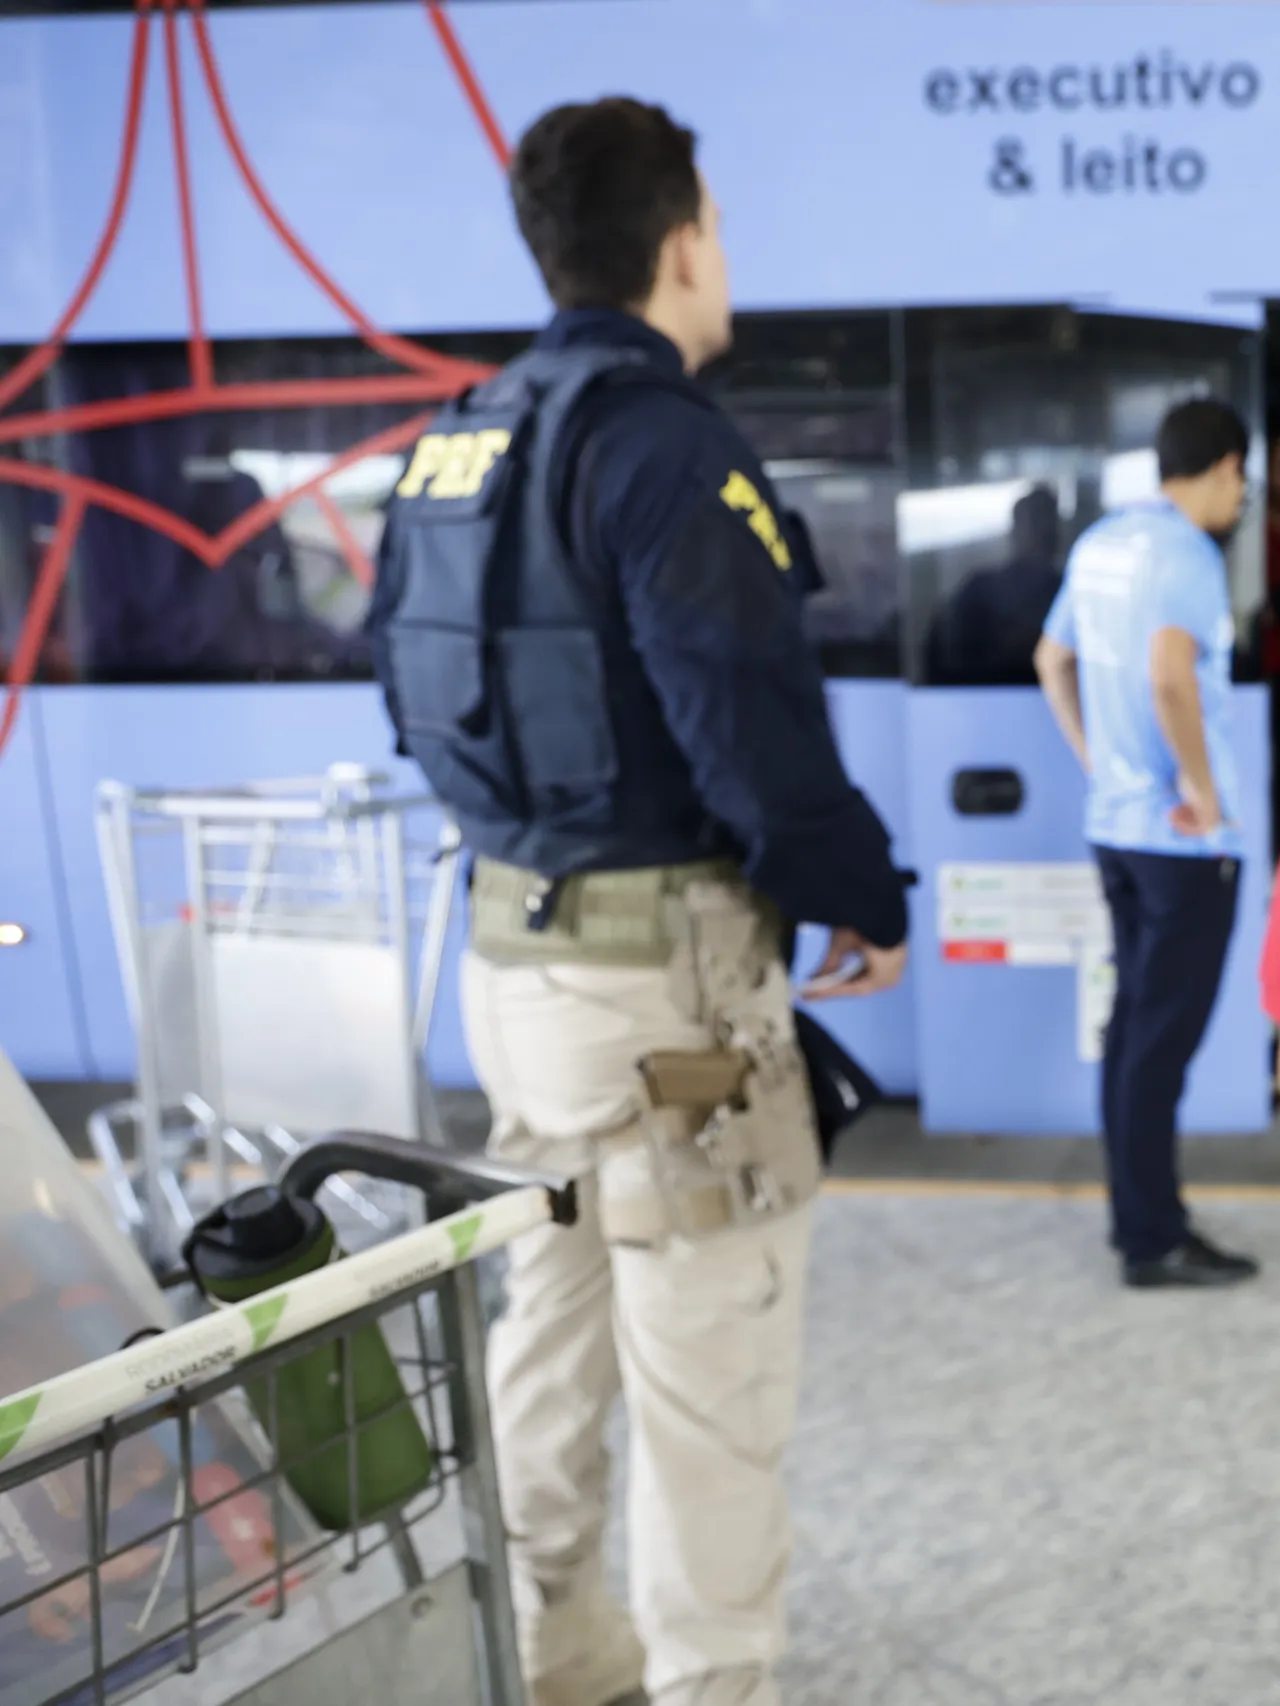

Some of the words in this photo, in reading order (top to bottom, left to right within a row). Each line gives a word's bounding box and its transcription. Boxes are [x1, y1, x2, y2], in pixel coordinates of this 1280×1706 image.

[924, 46, 1260, 114] executivo
[987, 136, 1034, 196] &
[1060, 134, 1206, 195] leito
[145, 1344, 237, 1391] SALVADOR
